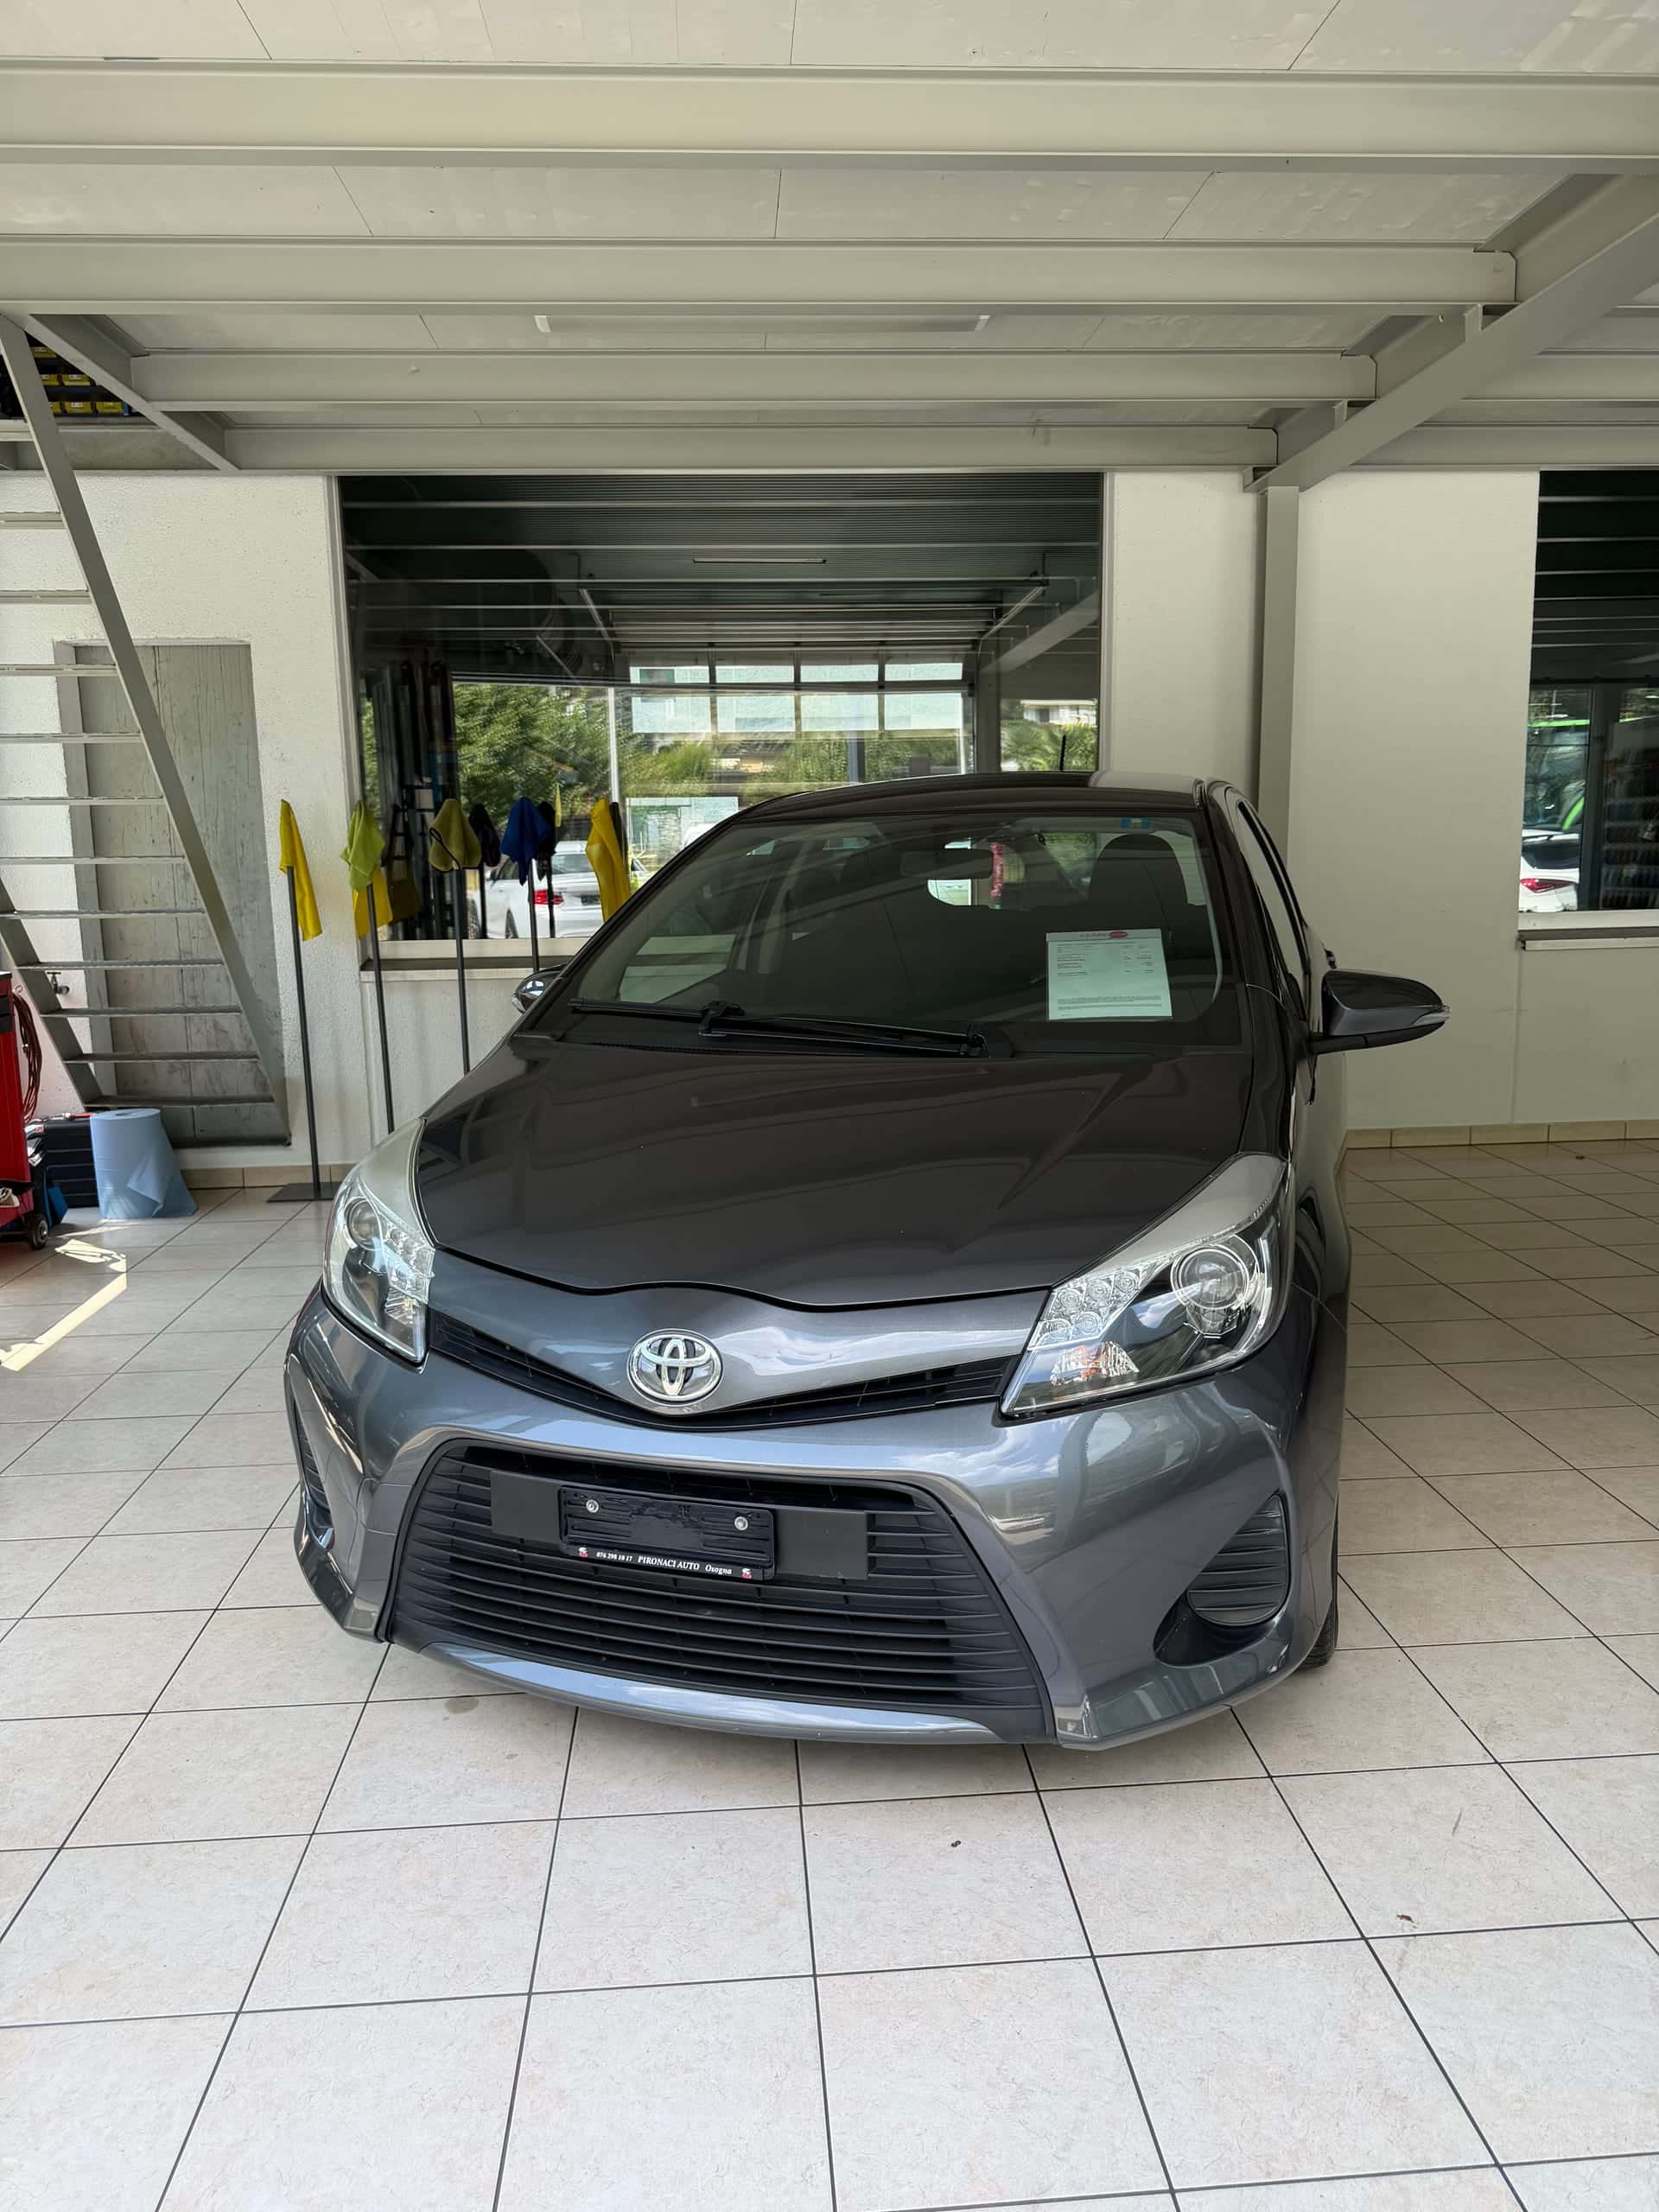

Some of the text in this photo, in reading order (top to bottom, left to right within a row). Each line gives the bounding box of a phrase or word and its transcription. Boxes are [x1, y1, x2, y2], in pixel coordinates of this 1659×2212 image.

[638, 1555, 676, 1567] PIRONACI
[677, 1560, 700, 1570] AUTO
[705, 1564, 732, 1574] Osogna
